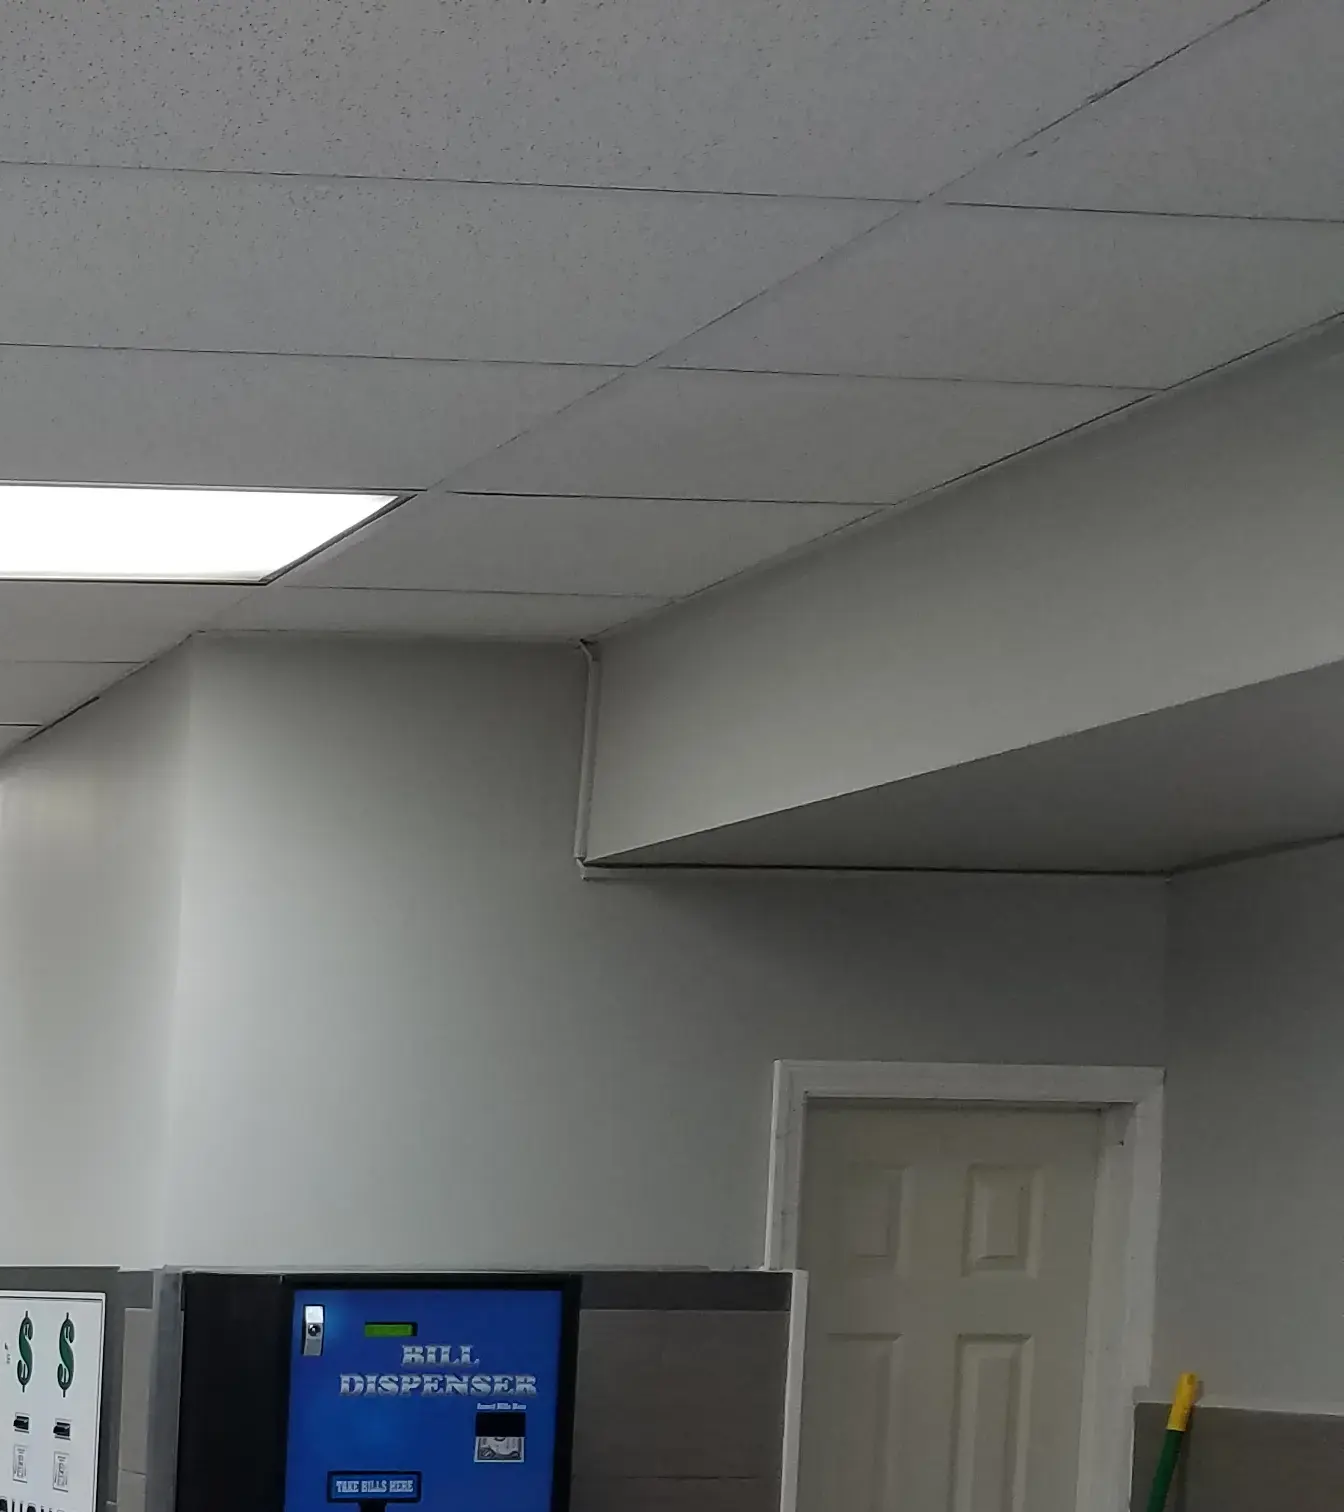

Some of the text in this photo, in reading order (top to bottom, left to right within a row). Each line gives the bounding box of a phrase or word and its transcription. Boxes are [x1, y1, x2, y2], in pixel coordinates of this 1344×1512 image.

[400, 1344, 480, 1367] BILL
[339, 1372, 538, 1396] DISPENSER
[336, 1480, 414, 1493] TAKE BILLS HERE
